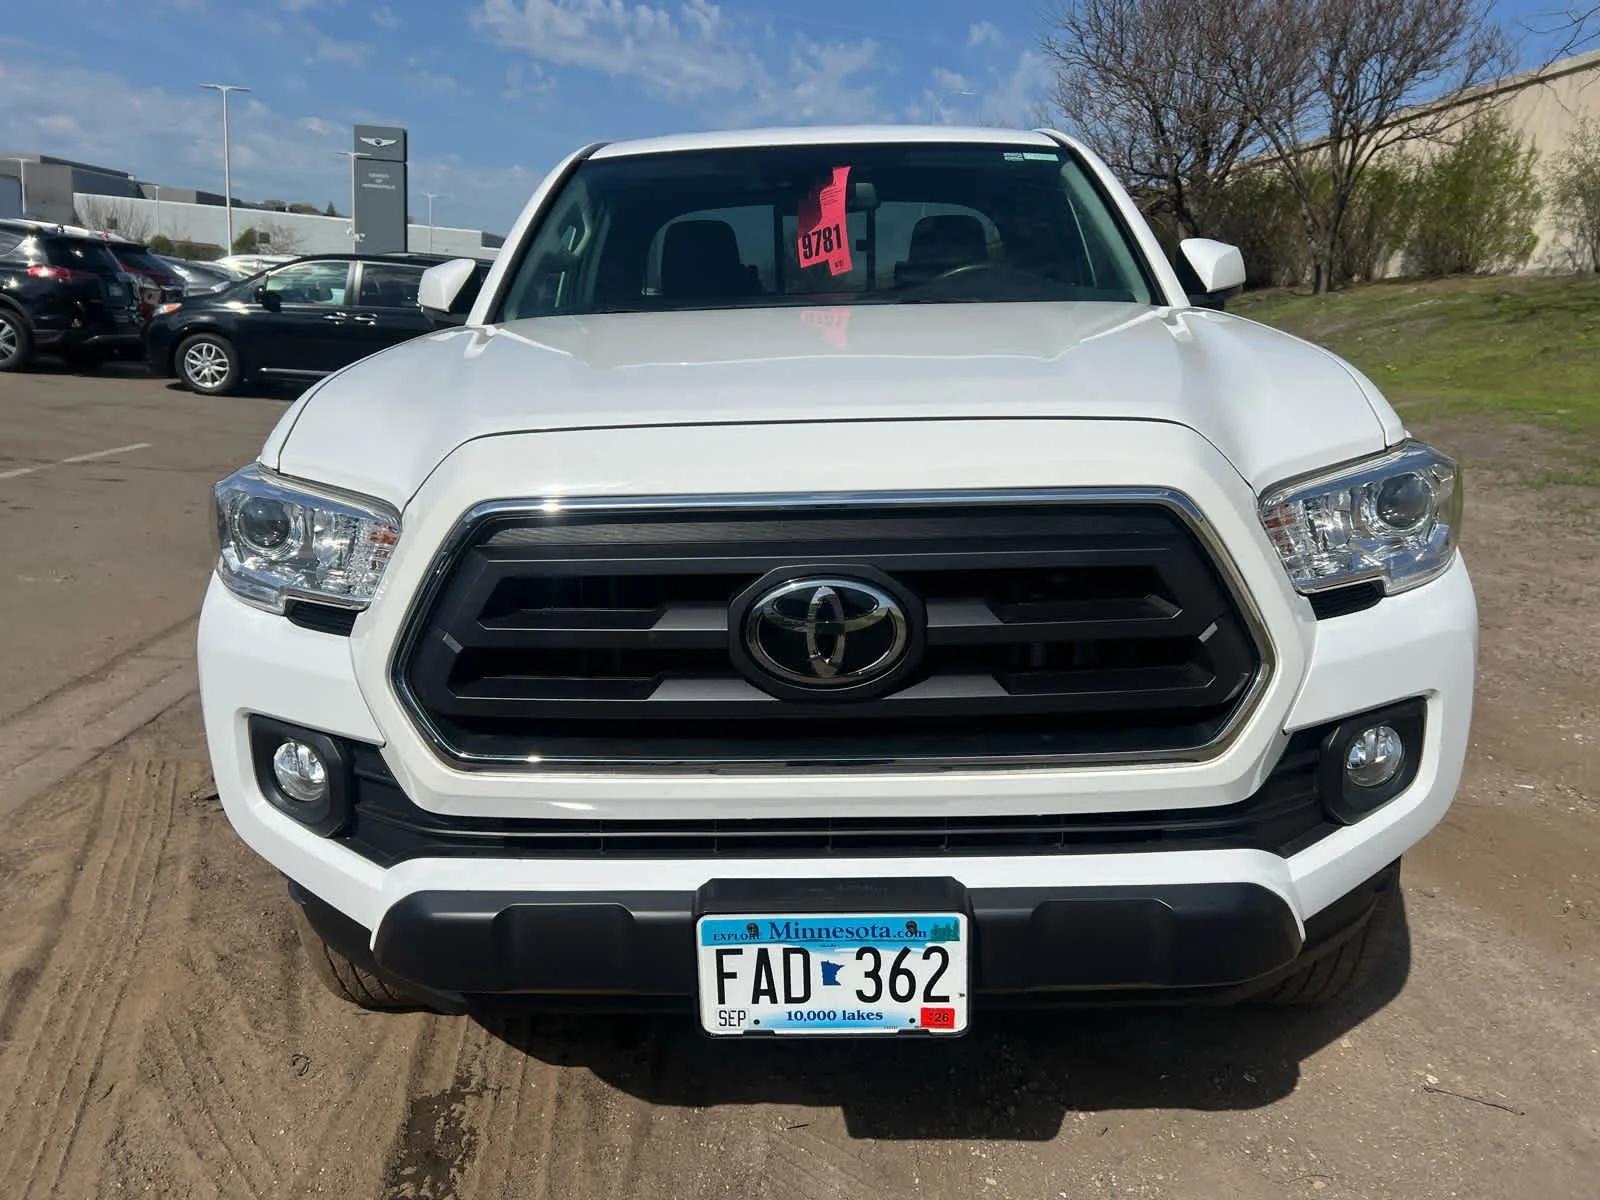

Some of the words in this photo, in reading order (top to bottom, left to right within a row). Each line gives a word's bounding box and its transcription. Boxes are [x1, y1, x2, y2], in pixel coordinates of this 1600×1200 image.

[802, 223, 842, 260] 9781
[715, 948, 812, 1004] FAD
[855, 946, 950, 1003] 362
[718, 1010, 746, 1027] SEP
[786, 1010, 837, 1022] 10,000
[842, 1010, 884, 1021] lakes
